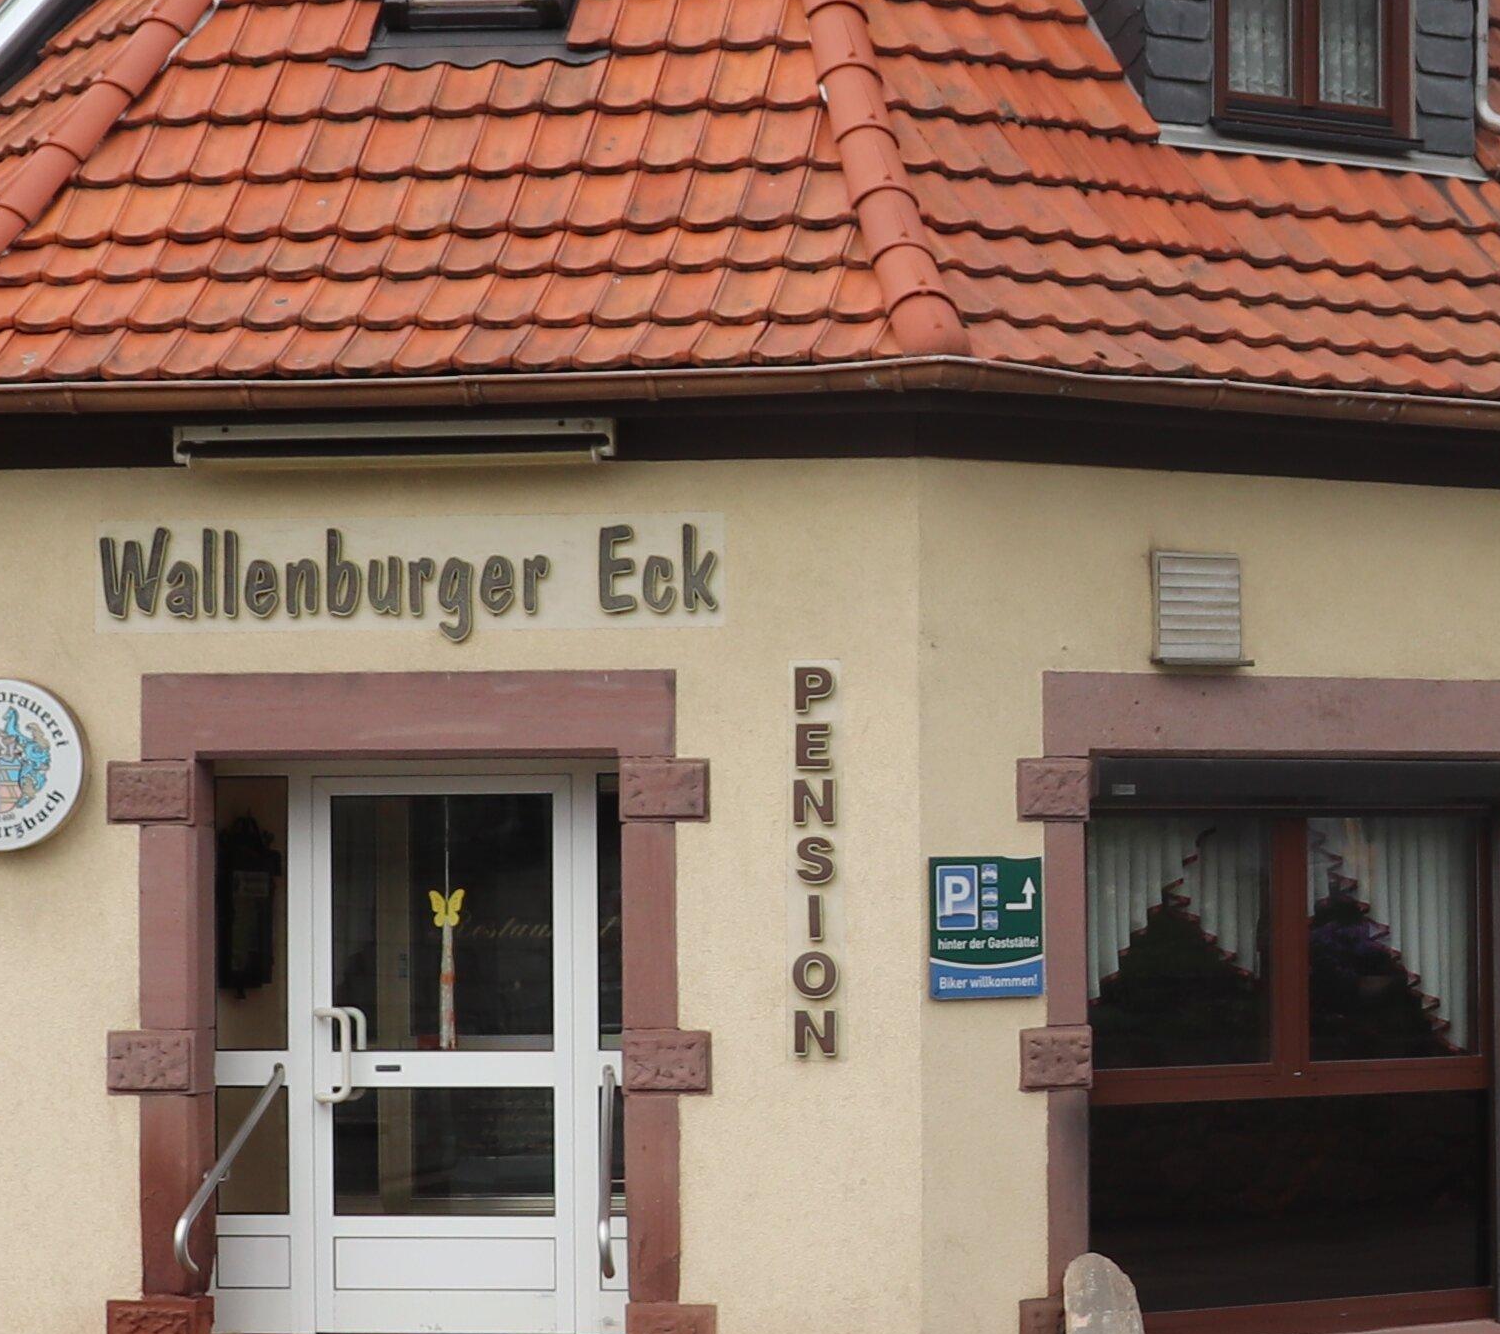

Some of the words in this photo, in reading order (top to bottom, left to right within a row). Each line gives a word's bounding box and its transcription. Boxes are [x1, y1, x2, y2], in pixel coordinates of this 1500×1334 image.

[99, 525, 552, 644] Wallenburger
[598, 522, 719, 615] Eck
[792, 665, 840, 1058] PENSION
[943, 874, 972, 917] P
[937, 937, 967, 951] hinter
[969, 937, 987, 950] der
[987, 935, 1040, 949] Gaststätte!
[939, 975, 969, 990] Biker
[969, 972, 1039, 989] willkommen!
